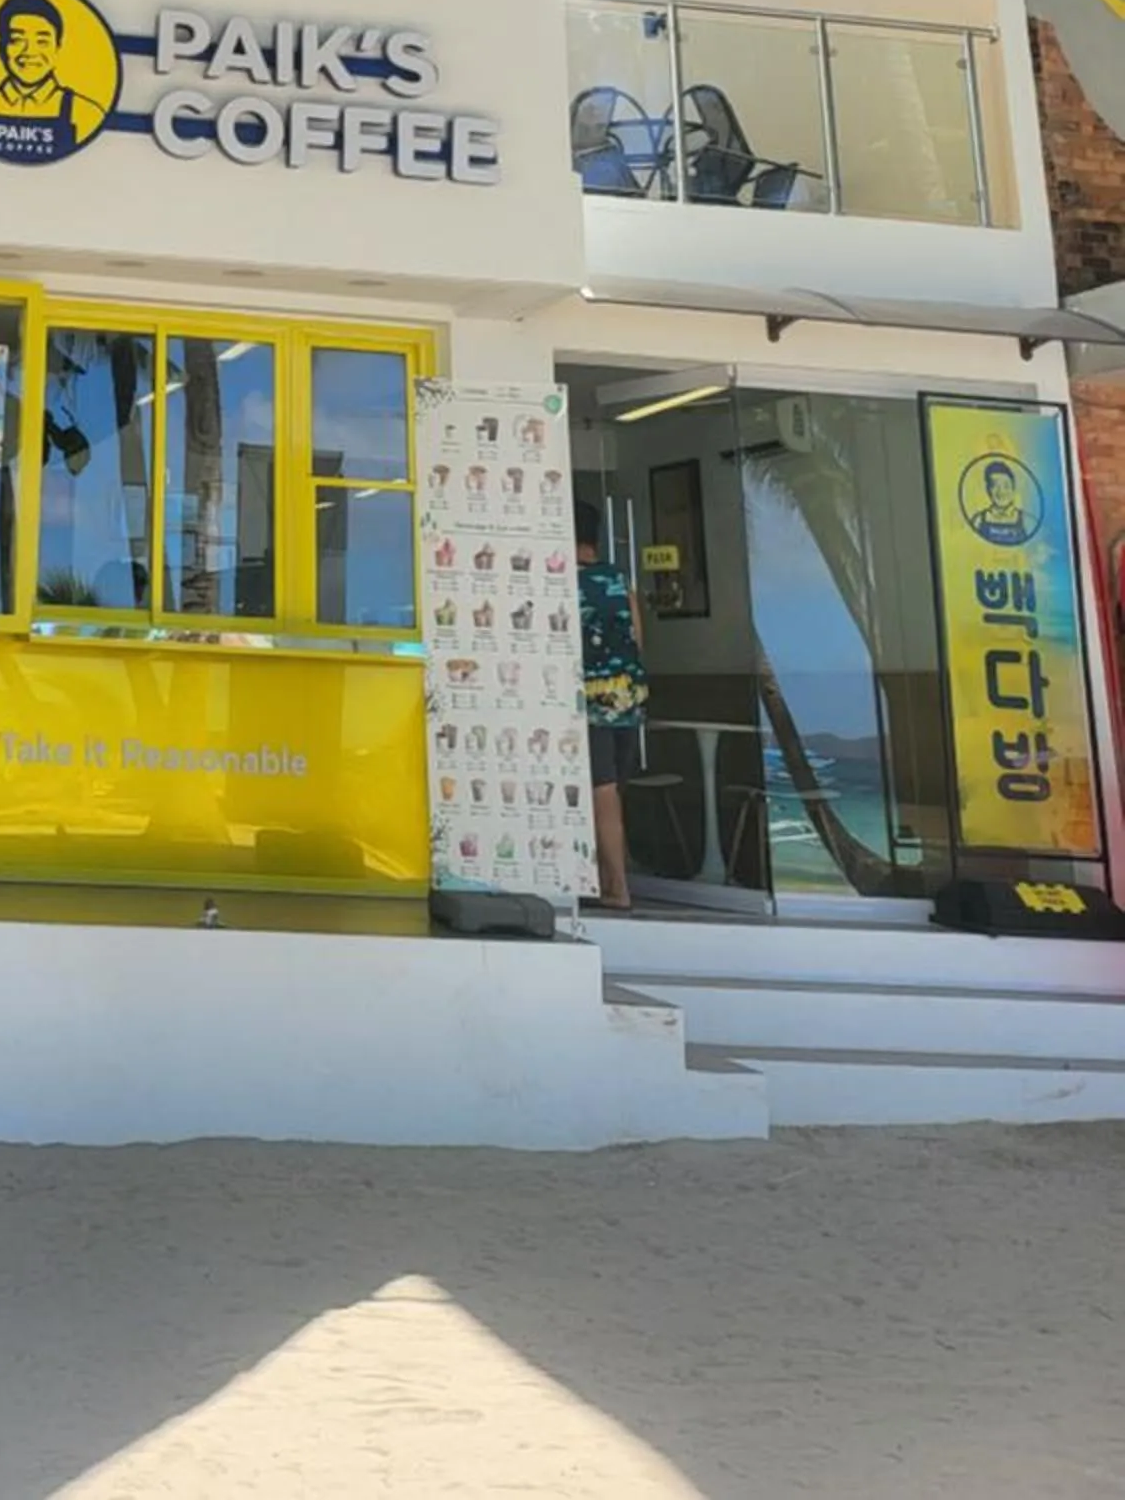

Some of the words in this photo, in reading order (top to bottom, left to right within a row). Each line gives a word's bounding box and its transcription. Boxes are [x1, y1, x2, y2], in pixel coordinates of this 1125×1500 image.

[155, 9, 440, 99] PAIK'S
[151, 91, 501, 184] COFFEE
[975, 569, 1052, 802] 빽다방
[0, 731, 73, 767] Take
[121, 737, 308, 777] Reasonable
